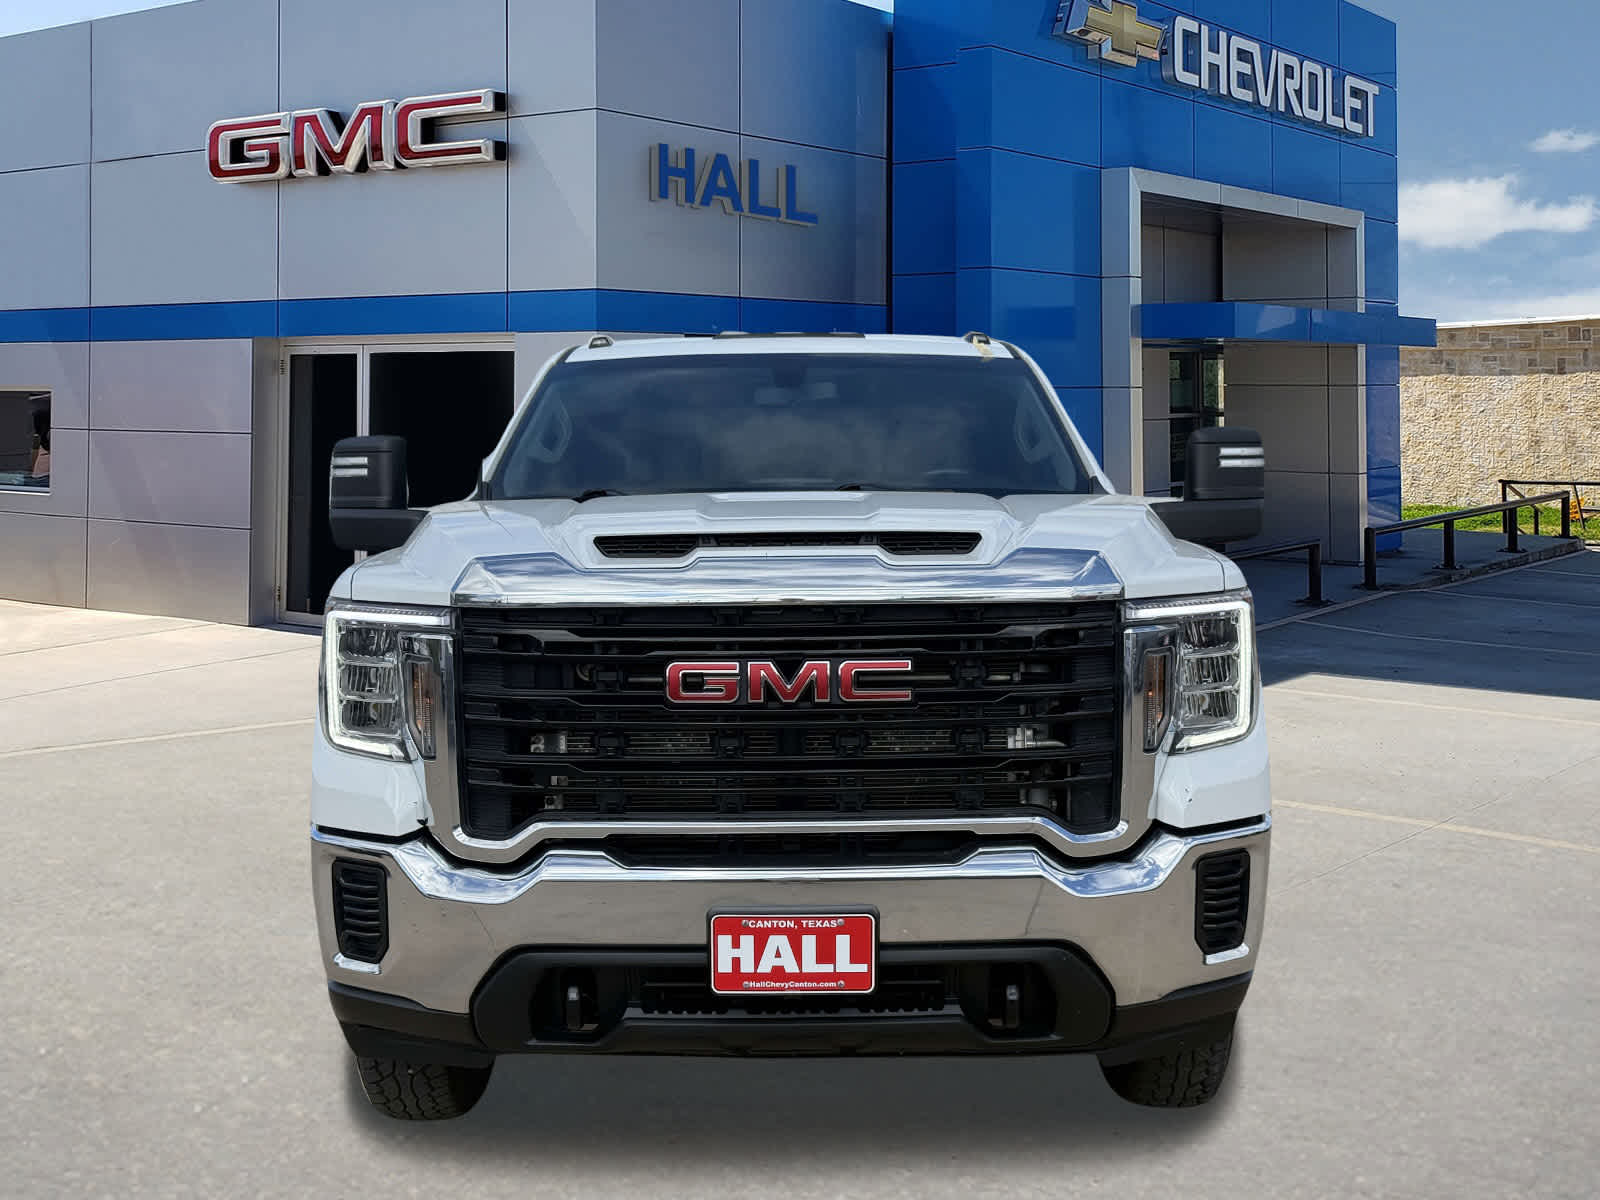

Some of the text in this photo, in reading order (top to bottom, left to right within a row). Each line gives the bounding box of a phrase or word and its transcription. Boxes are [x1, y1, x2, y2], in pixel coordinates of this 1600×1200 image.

[1173, 14, 1379, 137] CHEVROLET
[206, 88, 506, 184] GMC
[652, 143, 818, 225] HALL
[665, 659, 912, 703] GMC
[748, 919, 838, 930] CANTON, TEXAS
[717, 934, 869, 973] HALL
[749, 980, 837, 989] HallChevyCanton.com
